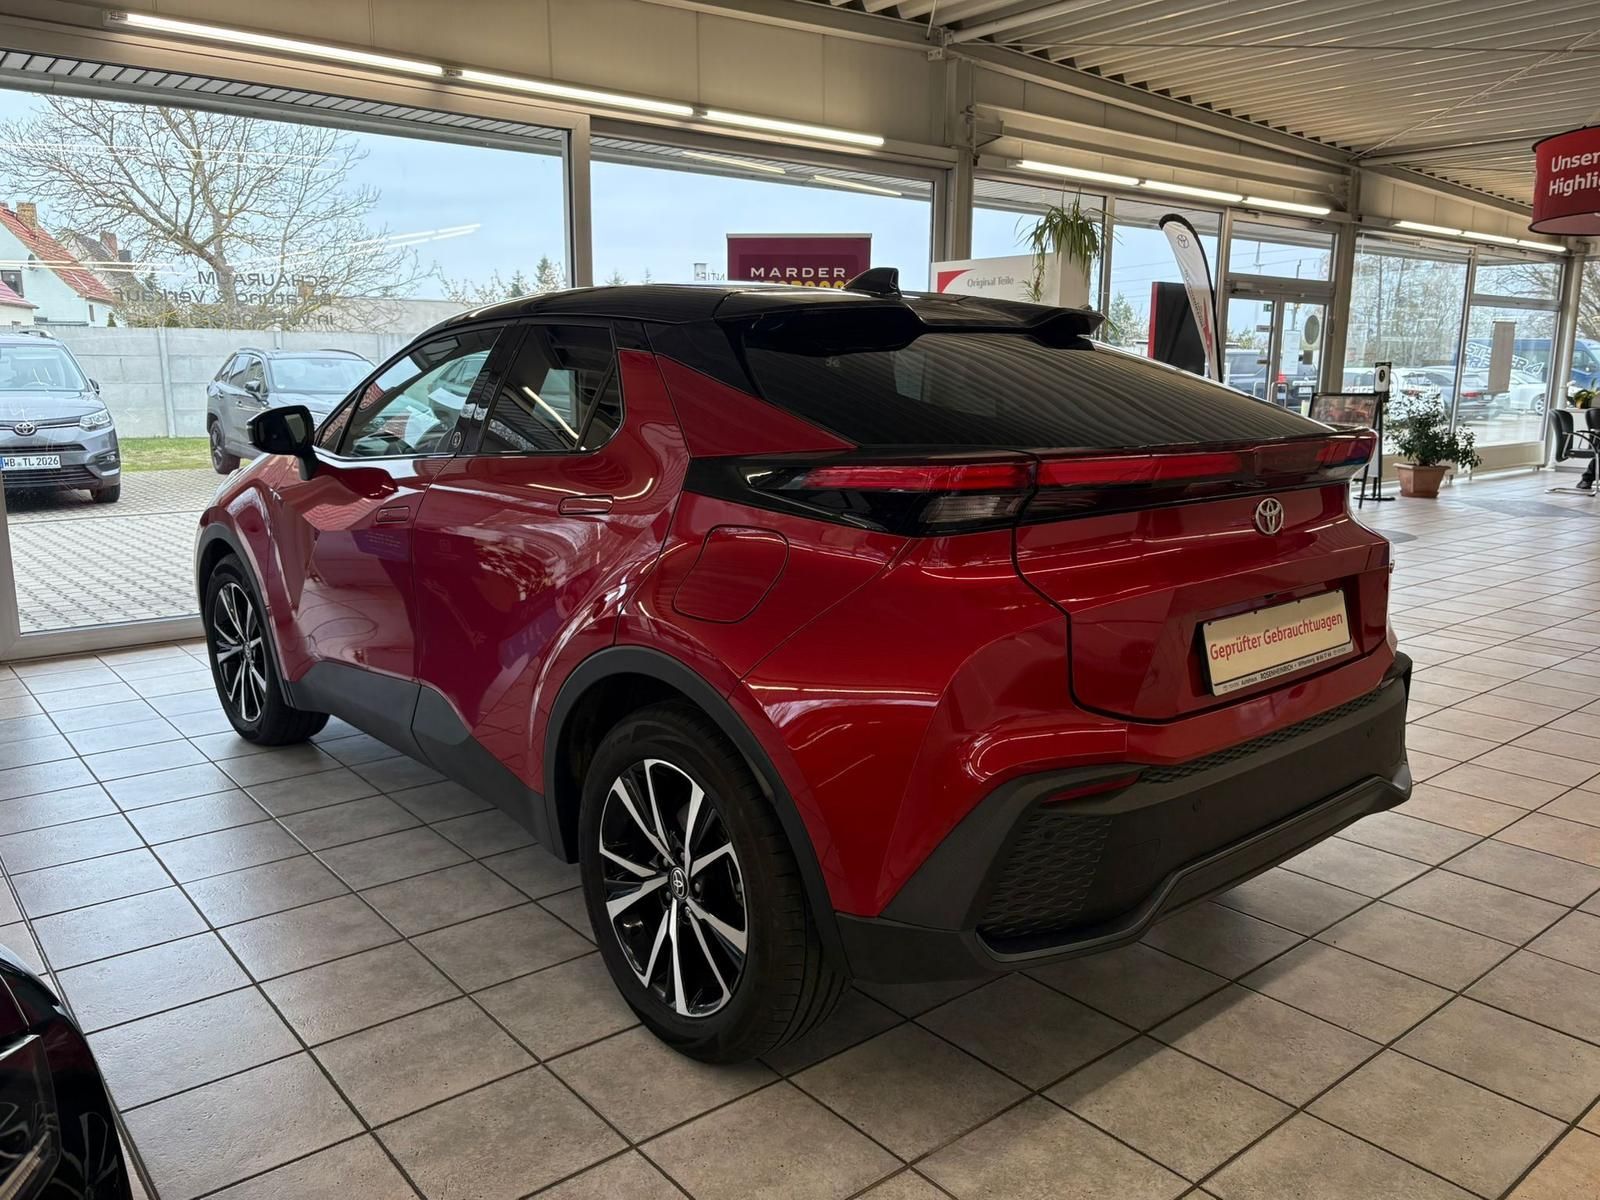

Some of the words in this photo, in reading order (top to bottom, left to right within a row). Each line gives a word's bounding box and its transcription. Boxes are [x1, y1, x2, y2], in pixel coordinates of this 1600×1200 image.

[1548, 171, 1600, 197] Highli
[750, 267, 846, 278] MARDER
[966, 276, 995, 289] Original
[22, 458, 35, 467] TL
[36, 456, 59, 466] 2026
[1210, 634, 1262, 661] Geprüfter
[1263, 612, 1344, 645] Gebrauchtwagen
